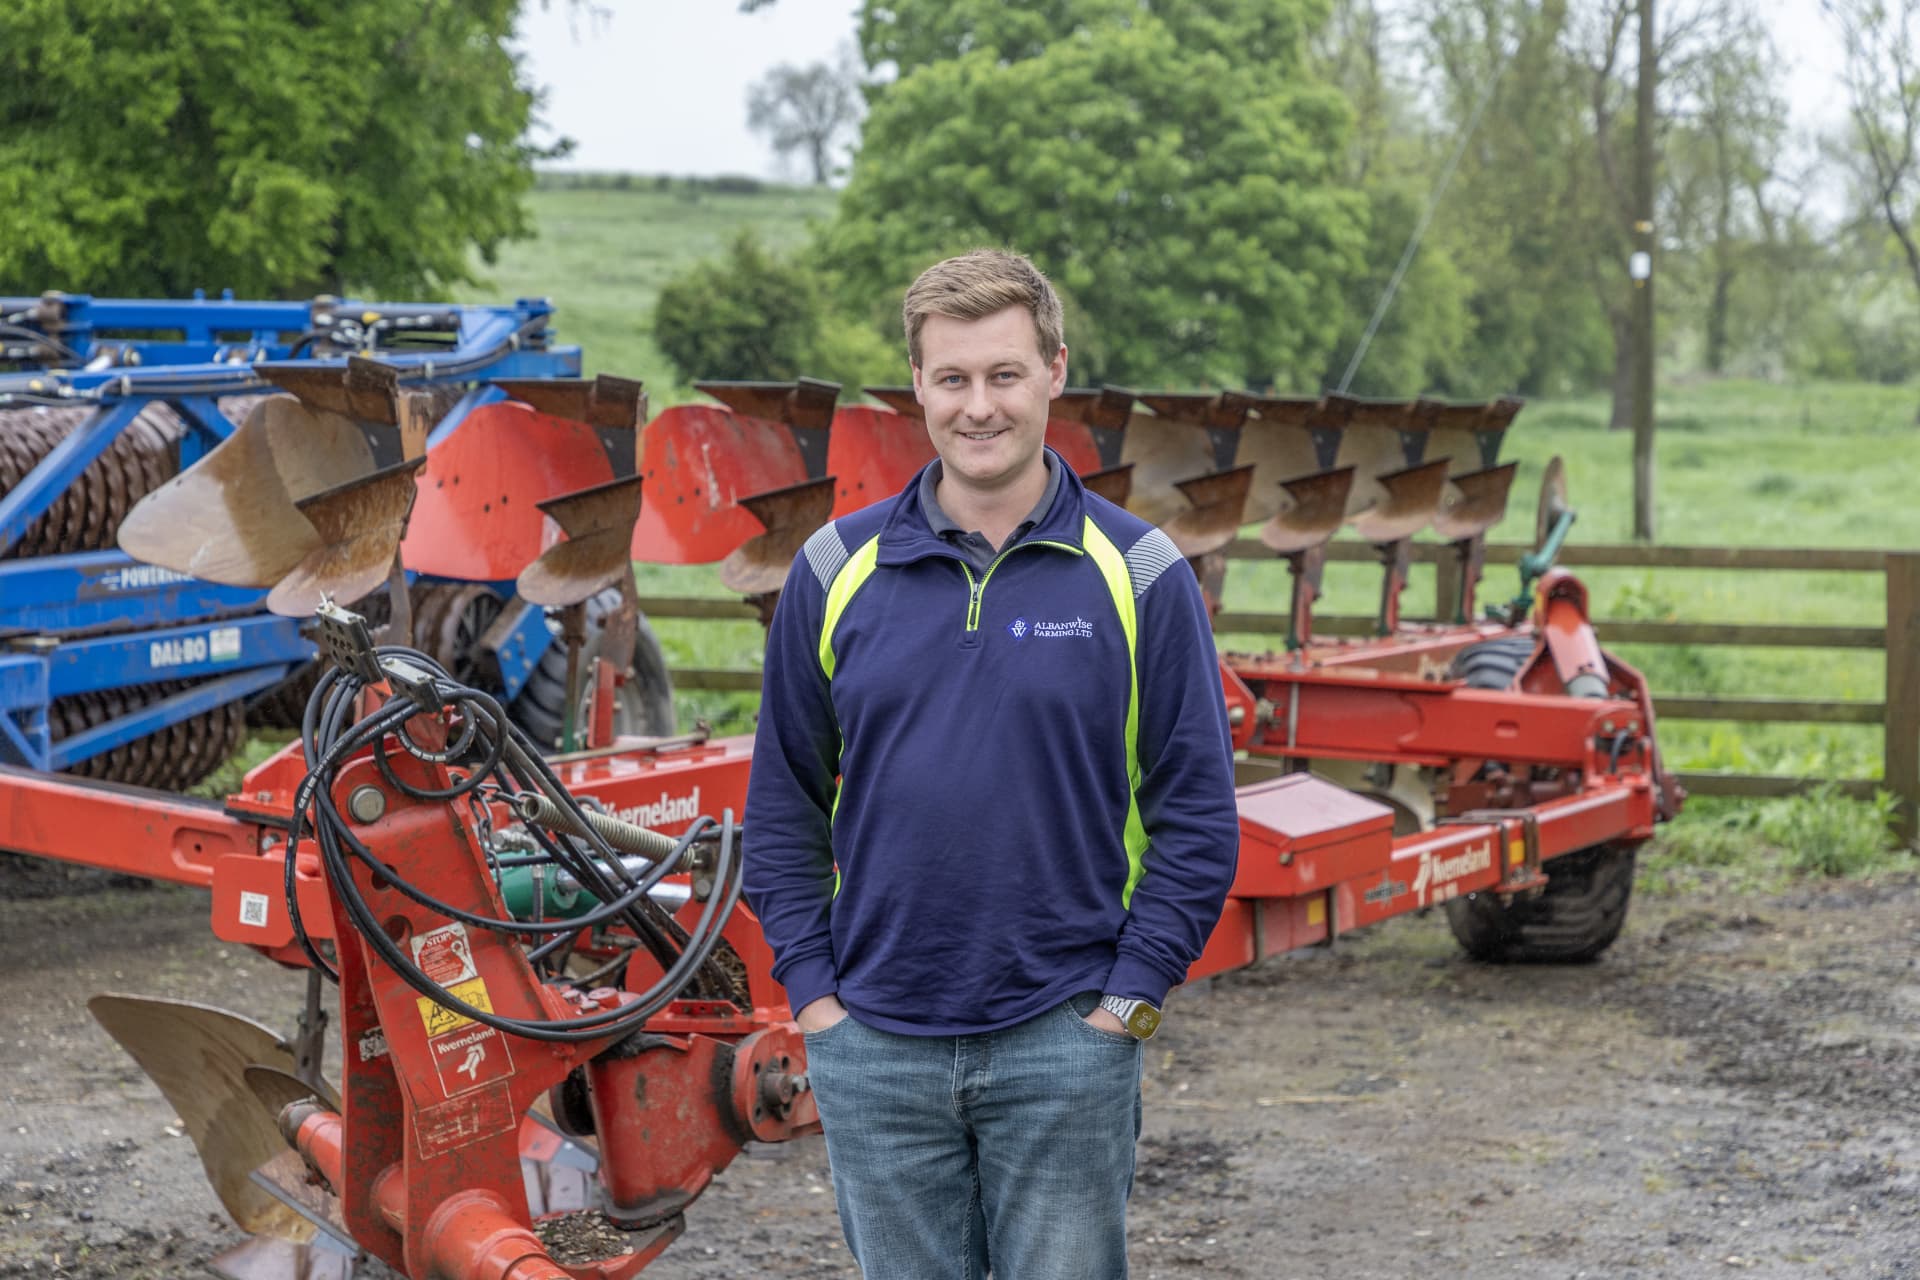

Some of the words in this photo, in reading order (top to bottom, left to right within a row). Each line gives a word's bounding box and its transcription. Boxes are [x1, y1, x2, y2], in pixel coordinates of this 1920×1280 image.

[1033, 629, 1074, 637] FARMING
[1075, 628, 1093, 638] LTD
[436, 1026, 497, 1055] Kverneland
